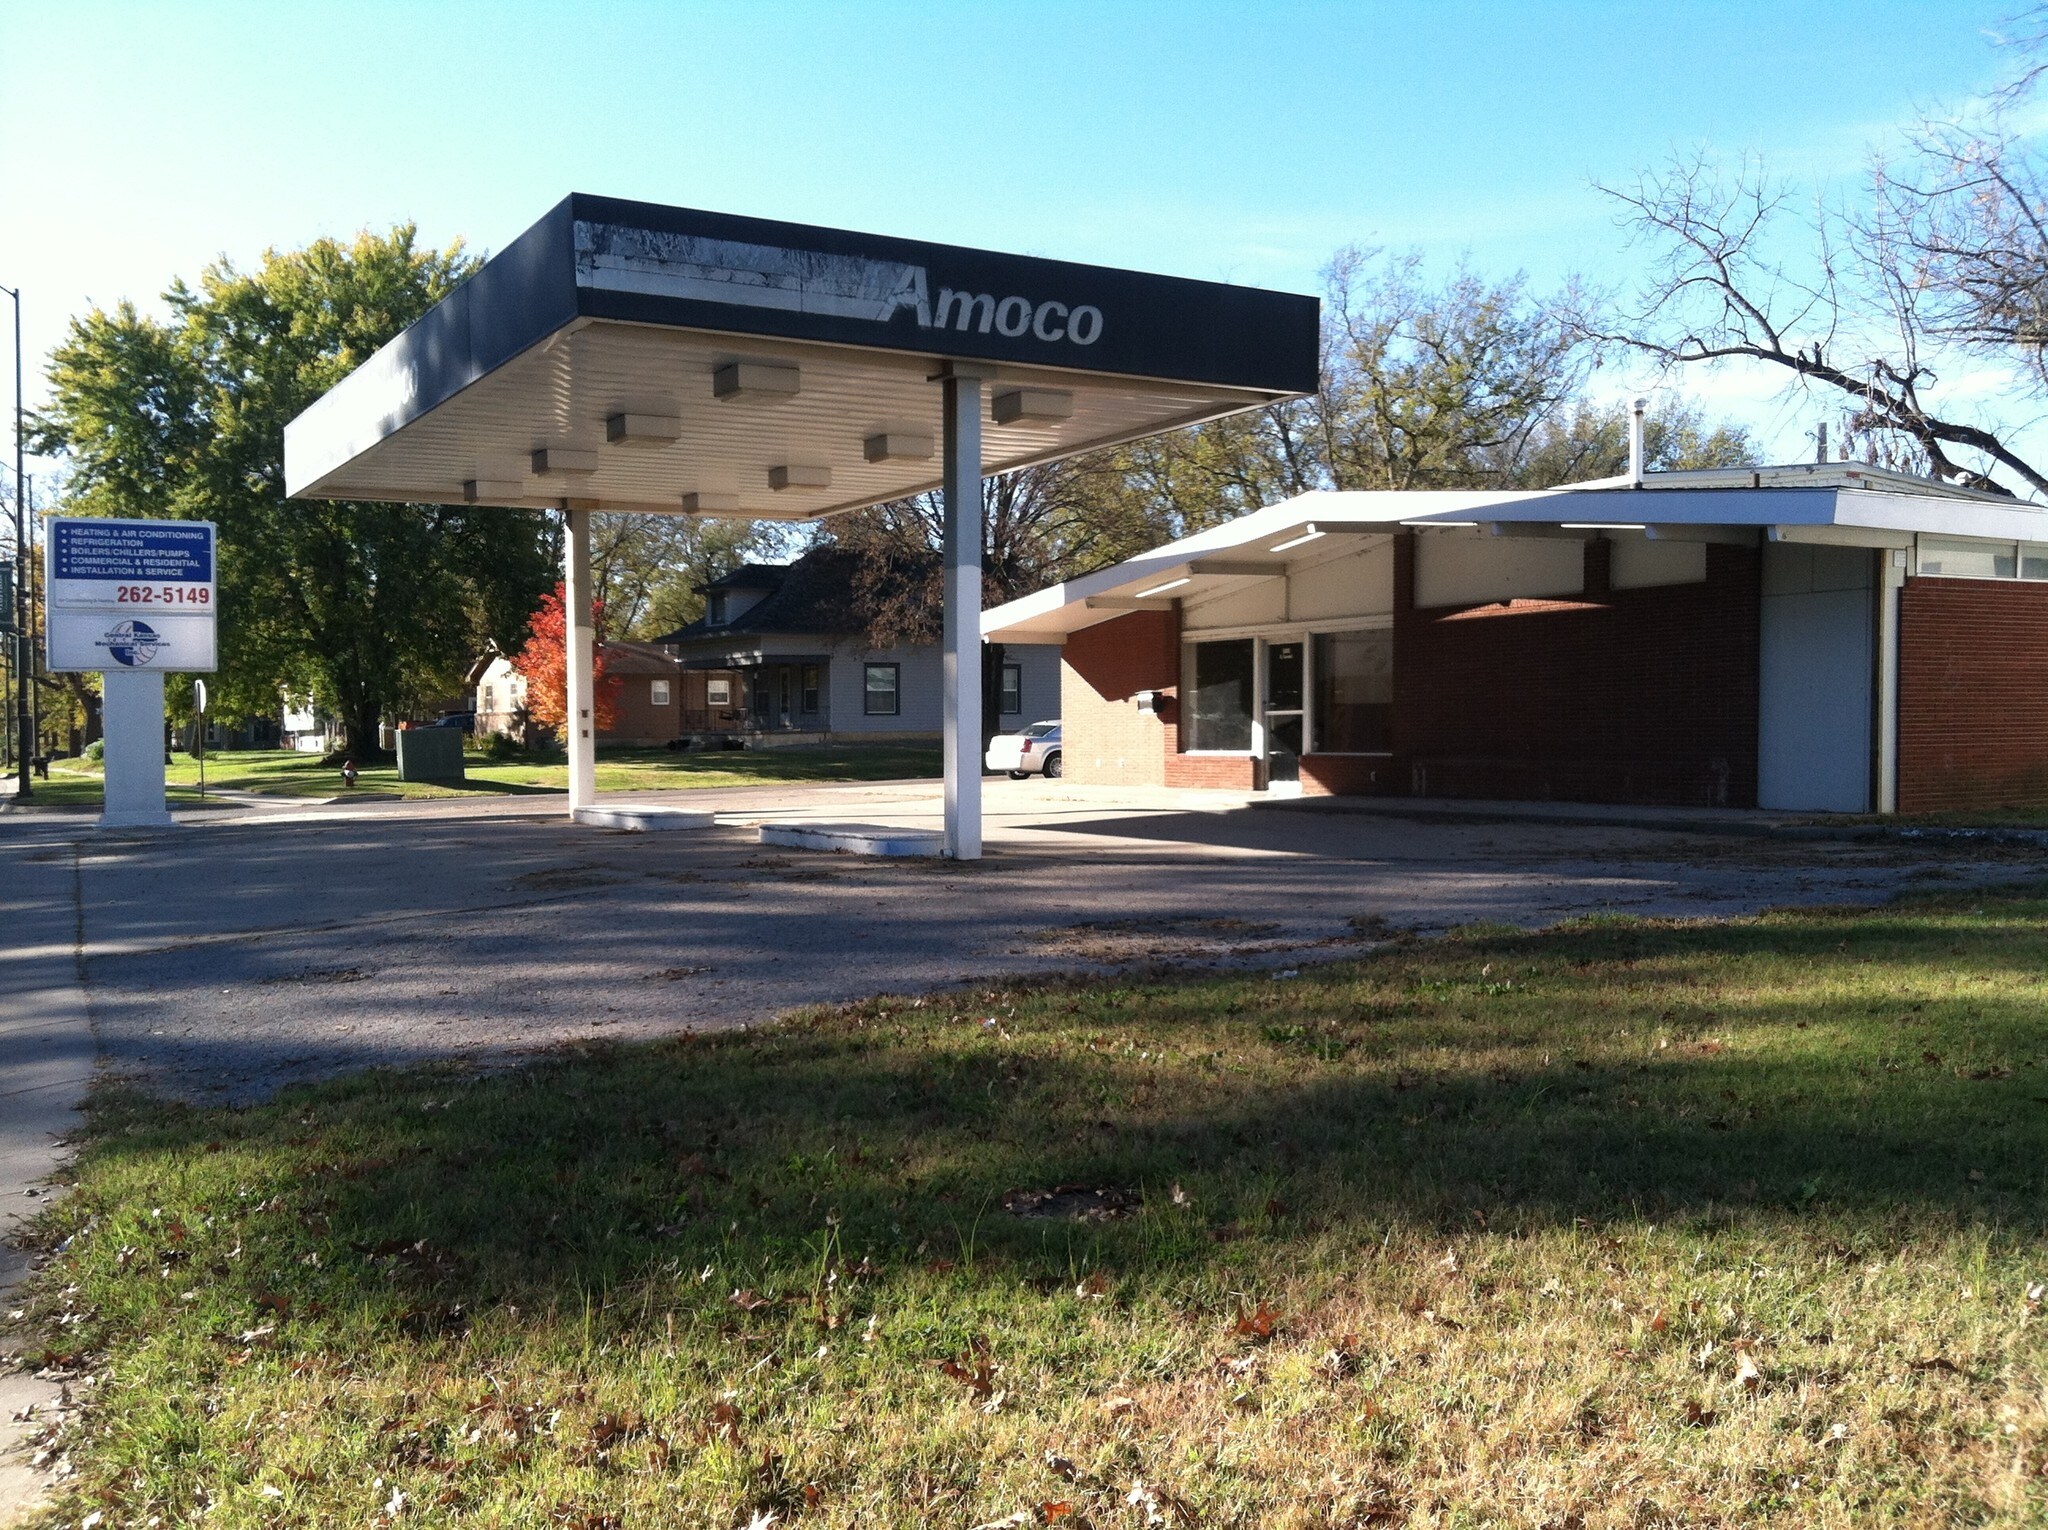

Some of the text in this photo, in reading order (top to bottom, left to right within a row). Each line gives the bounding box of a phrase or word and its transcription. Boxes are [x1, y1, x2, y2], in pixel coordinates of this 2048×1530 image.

[878, 264, 1104, 345] Amoco
[70, 528, 204, 540] HEATING & AIR CONDITIONING
[70, 538, 144, 547] REFRIGERATION
[70, 547, 190, 558] BOILERS/CHILLERS/PUMPS
[70, 557, 200, 567] COMMERCIAL & RESIDENTIAL
[70, 566, 184, 576] INSTALLATION & SERVICE
[117, 586, 209, 604] 262-5149
